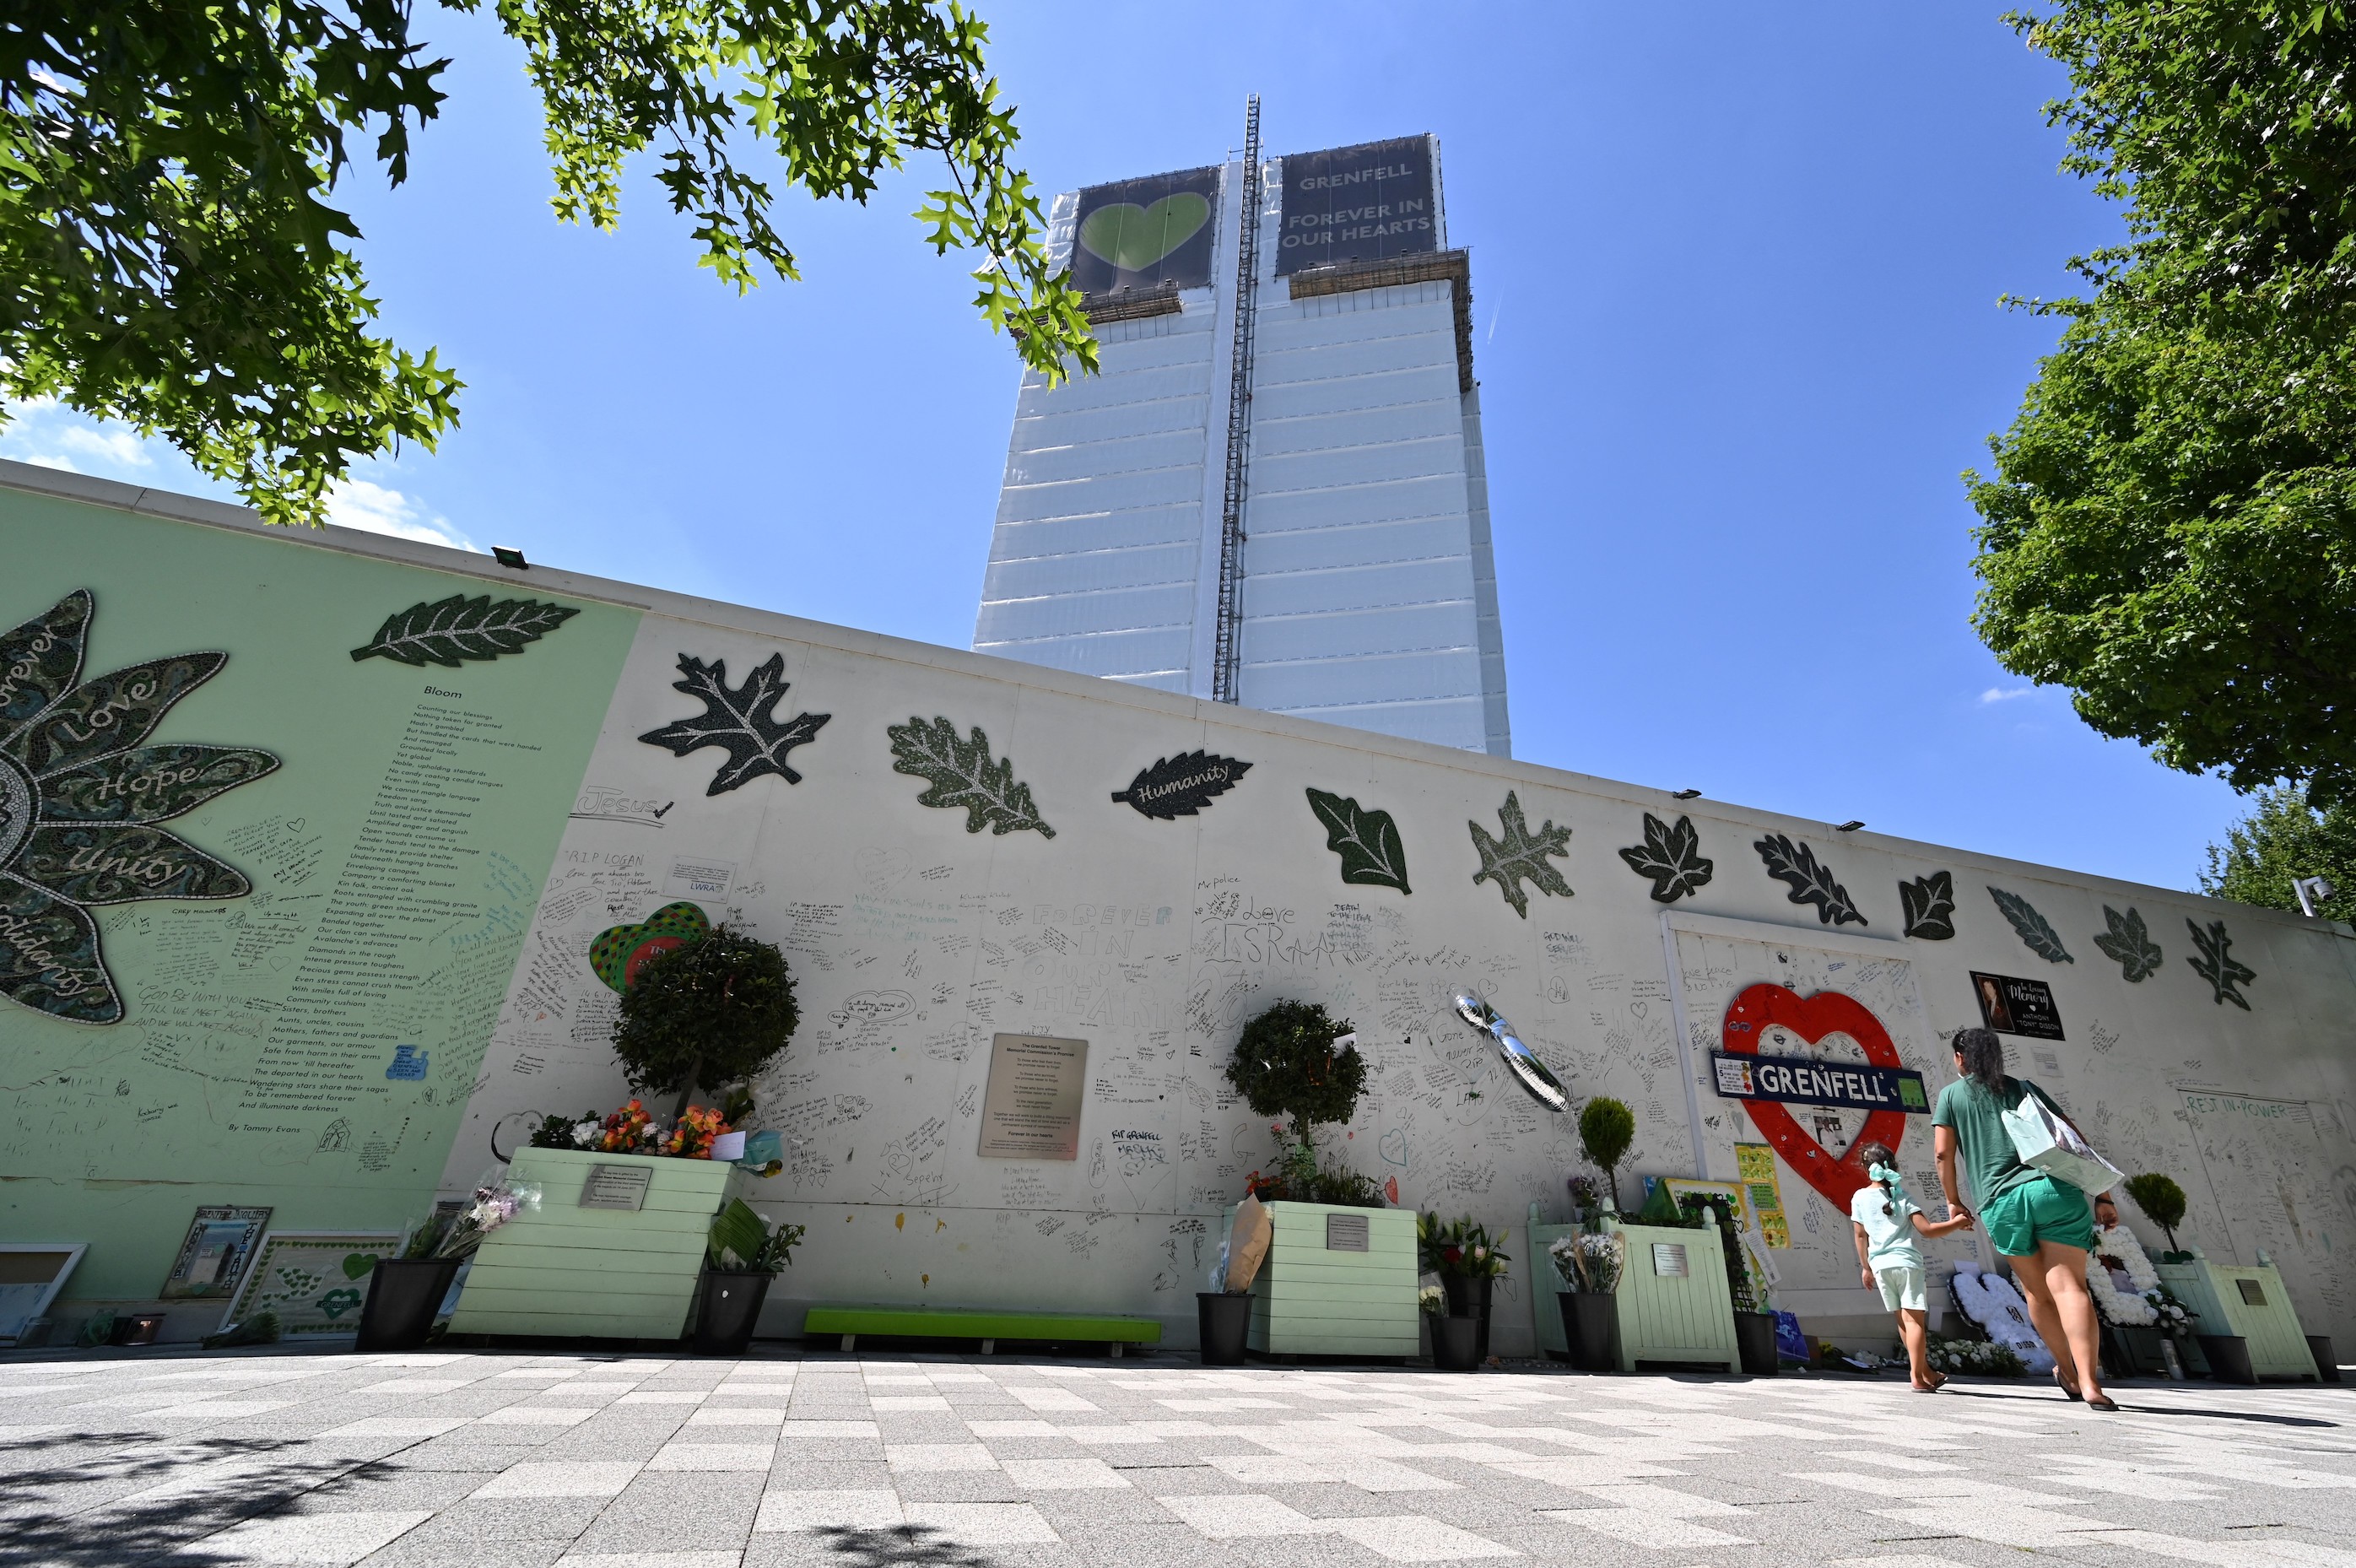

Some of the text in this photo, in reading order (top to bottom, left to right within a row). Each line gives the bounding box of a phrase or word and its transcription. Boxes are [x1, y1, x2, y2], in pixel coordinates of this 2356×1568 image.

[1300, 163, 1413, 190] GRENFELL
[1289, 198, 1424, 229] FOREVER IN
[1282, 217, 1430, 248] OUR HEARTS
[0, 624, 58, 708] orever
[424, 685, 462, 699] Bloom
[63, 680, 158, 743] Love
[413, 711, 440, 721] Nothing
[417, 704, 447, 714] Counting
[463, 711, 493, 721] blessings
[435, 724, 465, 733] gambled
[98, 766, 205, 800] Hope
[1137, 765, 1229, 803] Humanity
[577, 786, 657, 814] Jesus
[604, 853, 644, 866] LOGAN
[69, 846, 186, 887] Unity
[1213, 873, 1240, 889] police
[690, 883, 716, 893] LWRA
[1334, 903, 1359, 911] DEATH
[192, 992, 222, 1003] WITH
[224, 996, 247, 1008] YOU
[286, 995, 366, 1008] Community cushions
[2007, 984, 2049, 1010] Memory
[173, 1007, 189, 1015] WE
[192, 1008, 219, 1018] MEET
[282, 1005, 347, 1016] Sisters, brothers
[277, 1016, 302, 1025] Aunts,
[305, 1018, 332, 1027] uncles,
[272, 1026, 308, 1035] Mothers,
[311, 1028, 340, 1036] fathers
[267, 1036, 284, 1045] Our
[347, 1041, 376, 1050] armour
[263, 1046, 282, 1055] Safe
[284, 1047, 304, 1056] from
[316, 1060, 355, 1069] hereafter
[271, 1068, 310, 1080] departed
[338, 1072, 364, 1080] hearts
[250, 1079, 294, 1089] Wandering
[1759, 1065, 1888, 1102] GRENFELL
[270, 1092, 324, 1100] remembered
[324, 1094, 356, 1102] forever
[258, 1102, 299, 1111] illuminate
[301, 1104, 338, 1112] darkness
[2240, 1100, 2288, 1118] POWER
[228, 1123, 300, 1133] By Tommy Evans
[1111, 1130, 1164, 1141] RIP GRENFELL
[240, 1223, 258, 1245] THE
